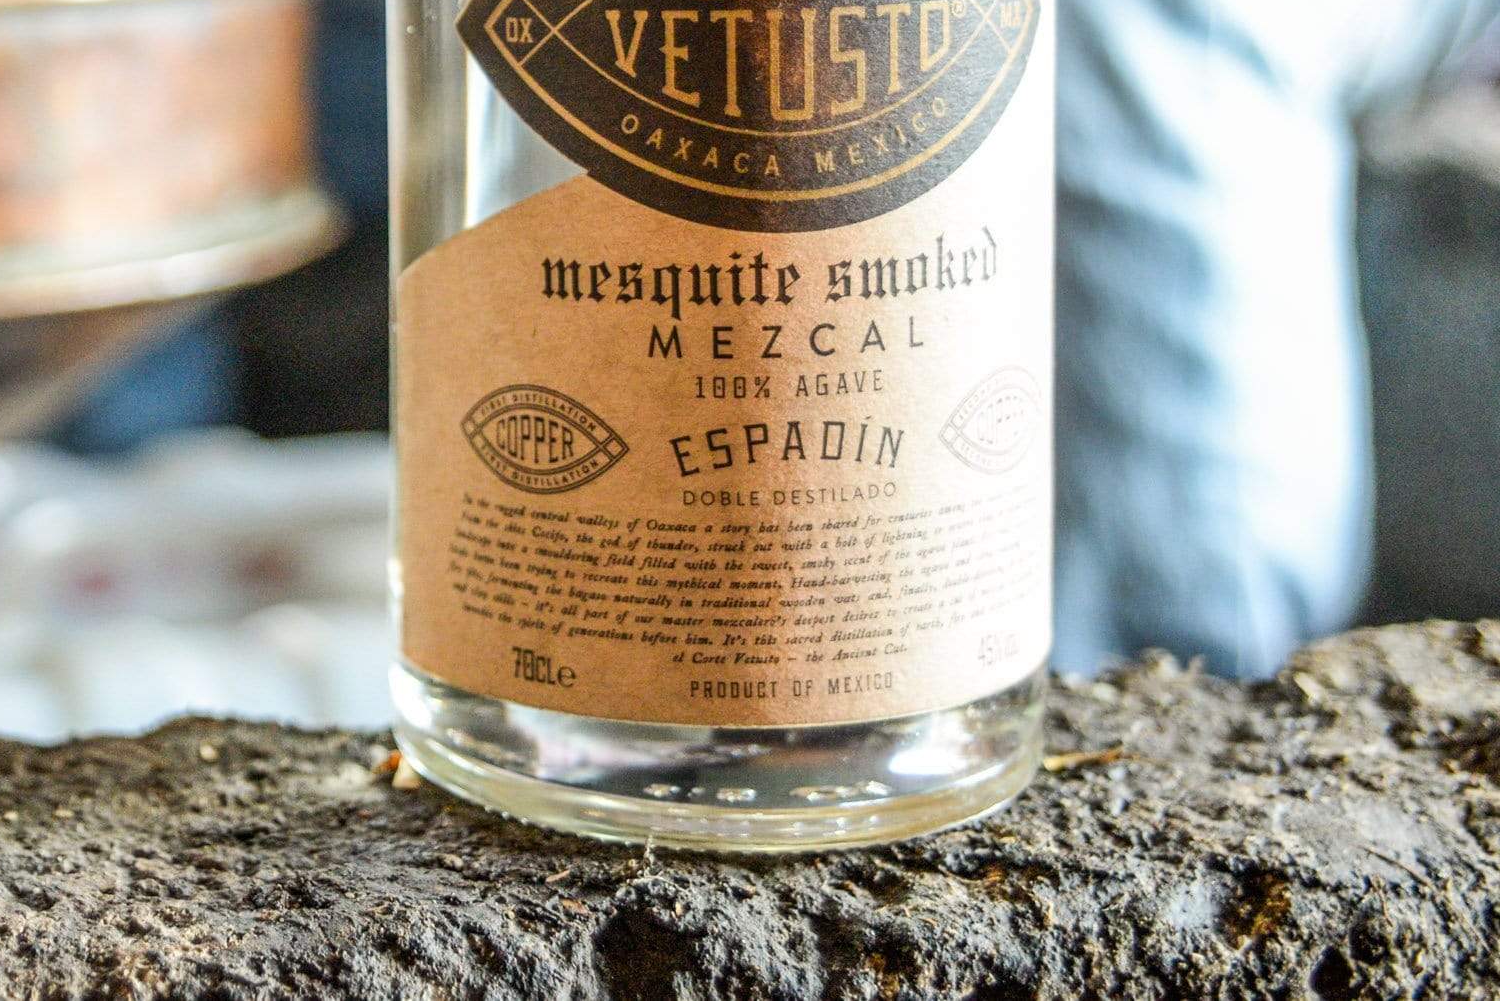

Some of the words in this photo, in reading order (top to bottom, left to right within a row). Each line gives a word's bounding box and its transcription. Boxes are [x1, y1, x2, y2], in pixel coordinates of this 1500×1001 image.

[504, 16, 533, 45] OX
[620, 113, 782, 178] OAXACA
[813, 96, 949, 174] MEXICO
[540, 250, 801, 321] mesquite
[824, 226, 999, 304] smoked
[647, 315, 925, 360] MEZCAL
[695, 375, 771, 399] 100%
[795, 369, 884, 397] AGAVE
[496, 414, 575, 464] COPPER
[668, 415, 905, 478] ESPADÍN
[682, 489, 761, 507] DOBLE
[772, 481, 897, 507] DESTILADO
[530, 511, 570, 523] central
[576, 515, 620, 530] valleys
[626, 518, 642, 533] of
[646, 519, 697, 533] Oaxaca
[704, 524, 713, 533] a
[720, 521, 752, 536] story
[758, 520, 780, 533] has
[786, 520, 814, 533] been
[820, 516, 860, 531] shared
[861, 514, 882, 530] for
[887, 509, 933, 524] centuries
[576, 532, 594, 544] the
[599, 535, 622, 549] god
[627, 537, 643, 551] of
[647, 538, 700, 553] thunder,
[707, 540, 746, 552] struck
[753, 541, 773, 552] out
[781, 539, 813, 552] with
[820, 540, 829, 549] a
[835, 535, 858, 548] bolt
[863, 533, 876, 549] of
[535, 547, 599, 566] smouldering
[603, 552, 636, 567] field
[638, 555, 677, 571] filled
[684, 558, 717, 571] with
[724, 559, 744, 571] the
[750, 560, 793, 572] sweet,
[801, 556, 835, 570] smoky
[843, 554, 871, 566] scent
[878, 549, 891, 565] of
[527, 562, 558, 580] trying
[565, 569, 576, 579] to
[582, 571, 629, 584] recreate
[636, 574, 659, 587] this
[666, 577, 722, 591] mythical
[729, 578, 782, 590] moment.
[791, 571, 892, 590] Hand-harvesting
[545, 584, 562, 597] the
[613, 593, 673, 609] naturally
[680, 596, 693, 608] in
[700, 596, 771, 608] traditional
[779, 595, 825, 608] wooden
[834, 593, 860, 604] vats
[867, 587, 893, 601] and,
[561, 603, 579, 616] all
[583, 608, 609, 621] part
[615, 609, 630, 624] of
[634, 615, 654, 624] our
[661, 616, 705, 626] master
[712, 615, 787, 628] mezcalero's
[794, 614, 835, 628] deepest
[842, 610, 880, 623] desires
[550, 620, 565, 635] of
[567, 626, 634, 640] generations
[641, 631, 677, 647] before
[685, 633, 713, 646] him.
[722, 633, 747, 646] It's
[754, 634, 777, 646] this
[785, 632, 823, 645] sacred
[830, 628, 893, 642] distillation
[899, 621, 911, 638] of
[691, 651, 727, 664] Corte
[734, 652, 780, 665] Vetusto
[804, 650, 824, 663] the
[832, 648, 877, 661] Ancient
[884, 641, 908, 655] Cut.
[689, 679, 778, 699] PRODUCT
[792, 678, 814, 698] OF
[827, 671, 893, 695] MEXICO
